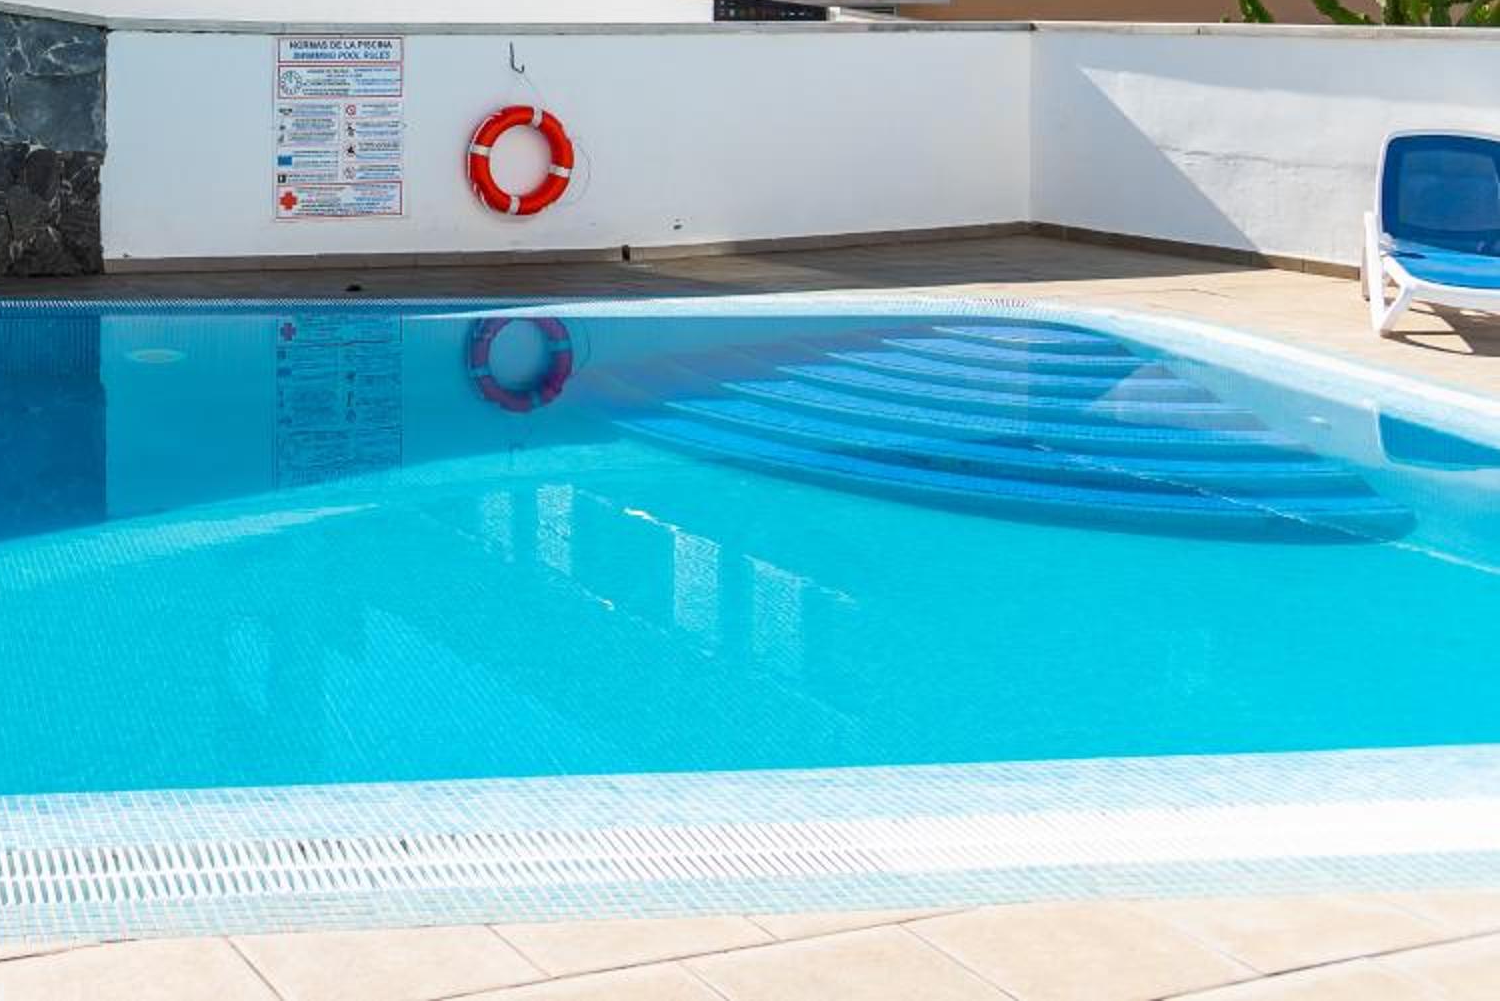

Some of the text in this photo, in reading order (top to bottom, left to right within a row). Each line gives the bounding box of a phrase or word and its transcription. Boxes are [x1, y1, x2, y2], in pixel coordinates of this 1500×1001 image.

[289, 41, 393, 50] NORMAS DE LA PISCINA
[338, 51, 360, 59] POOL
